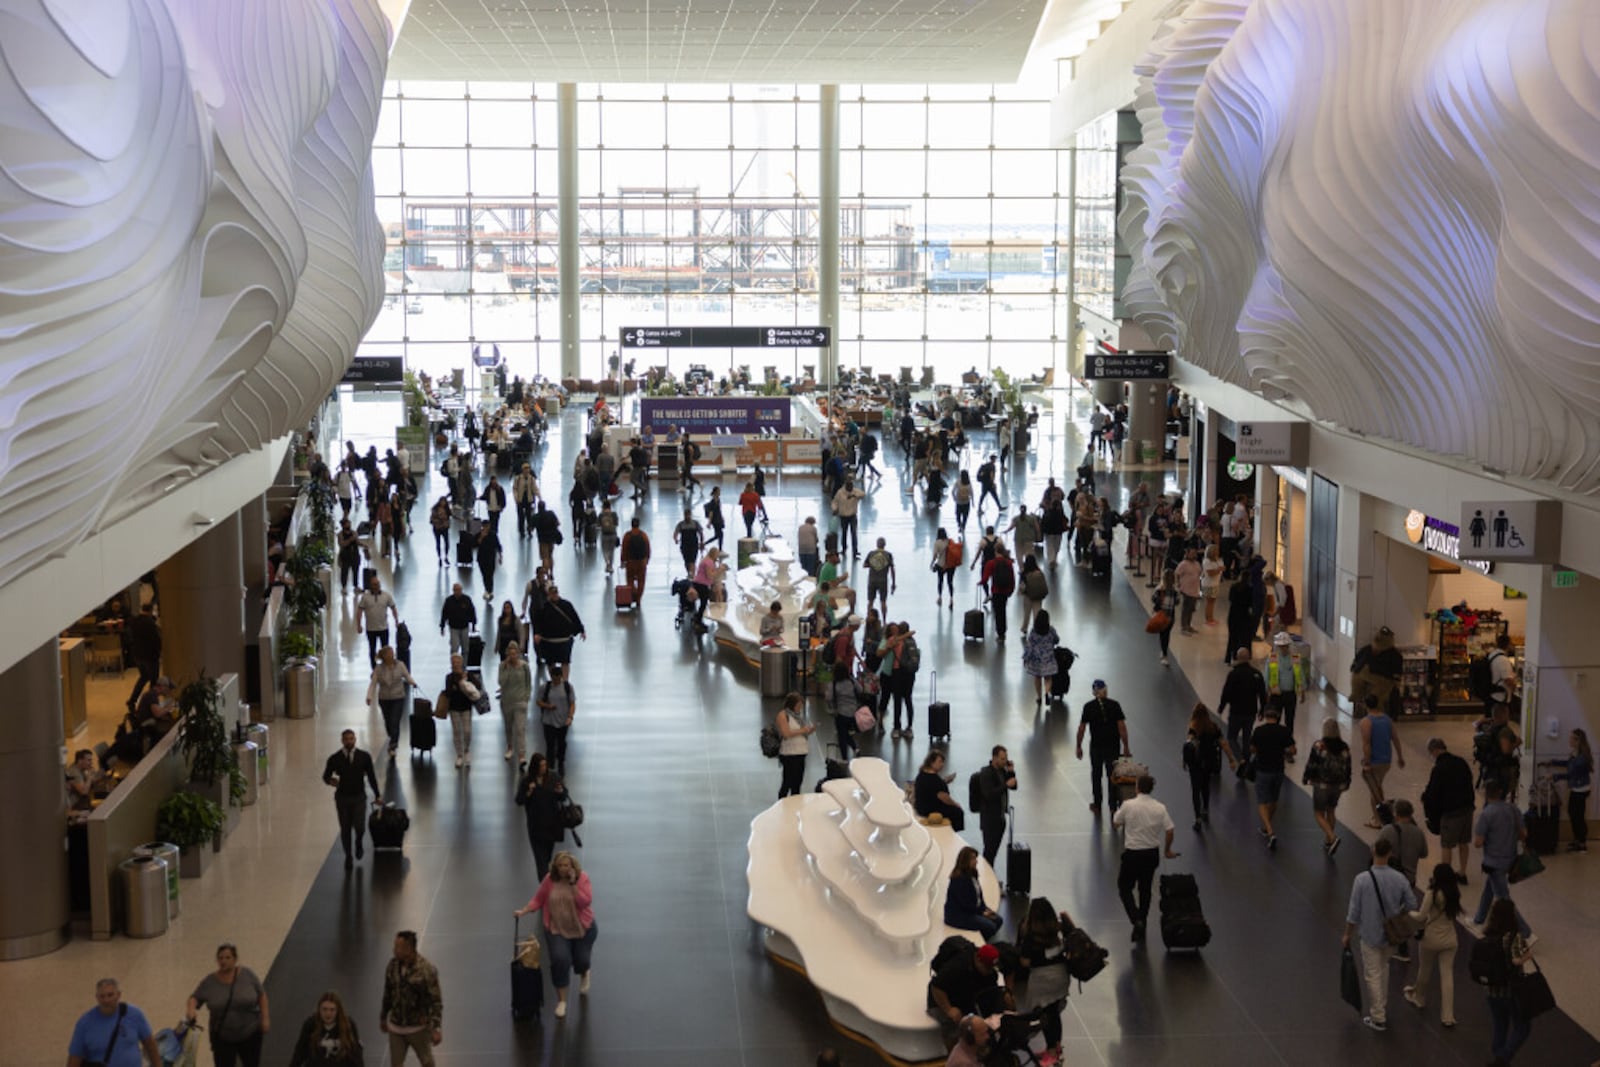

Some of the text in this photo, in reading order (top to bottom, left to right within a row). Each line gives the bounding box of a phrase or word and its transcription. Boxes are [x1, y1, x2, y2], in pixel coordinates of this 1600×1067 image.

[652, 409, 664, 418] THE
[665, 409, 683, 418] WALK
[683, 409, 691, 418] IS
[692, 409, 718, 418] GETTING
[719, 409, 748, 418] SHORTER
[1240, 438, 1262, 446] Flight
[1556, 572, 1577, 587] EXIT
